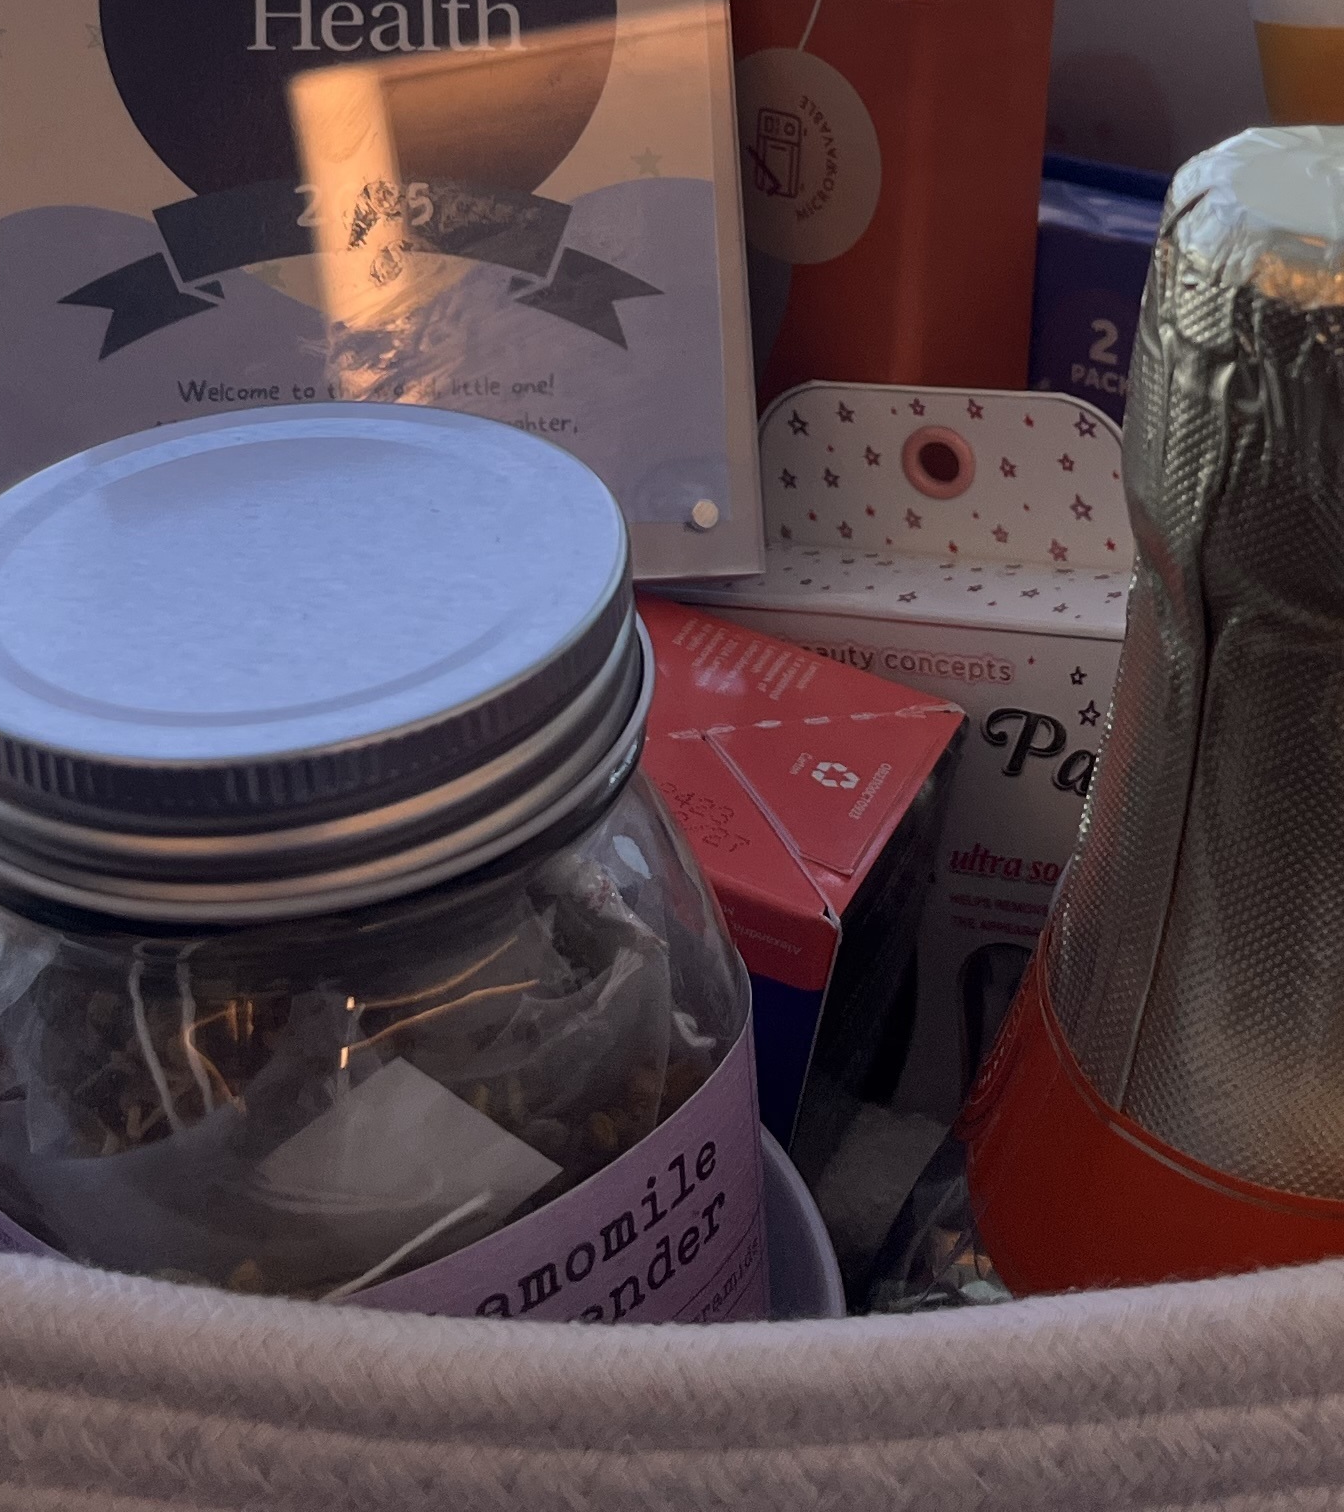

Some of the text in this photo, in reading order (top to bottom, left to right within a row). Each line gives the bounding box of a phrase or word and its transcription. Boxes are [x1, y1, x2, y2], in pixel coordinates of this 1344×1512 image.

[1088, 318, 1119, 366] 2
[177, 377, 281, 404] Welcome
[292, 384, 317, 401] to
[451, 374, 501, 398] little
[510, 372, 556, 396] one!
[883, 651, 1013, 685] concepts
[949, 842, 1023, 878] ultra
[475, 1139, 718, 1320] amomile
